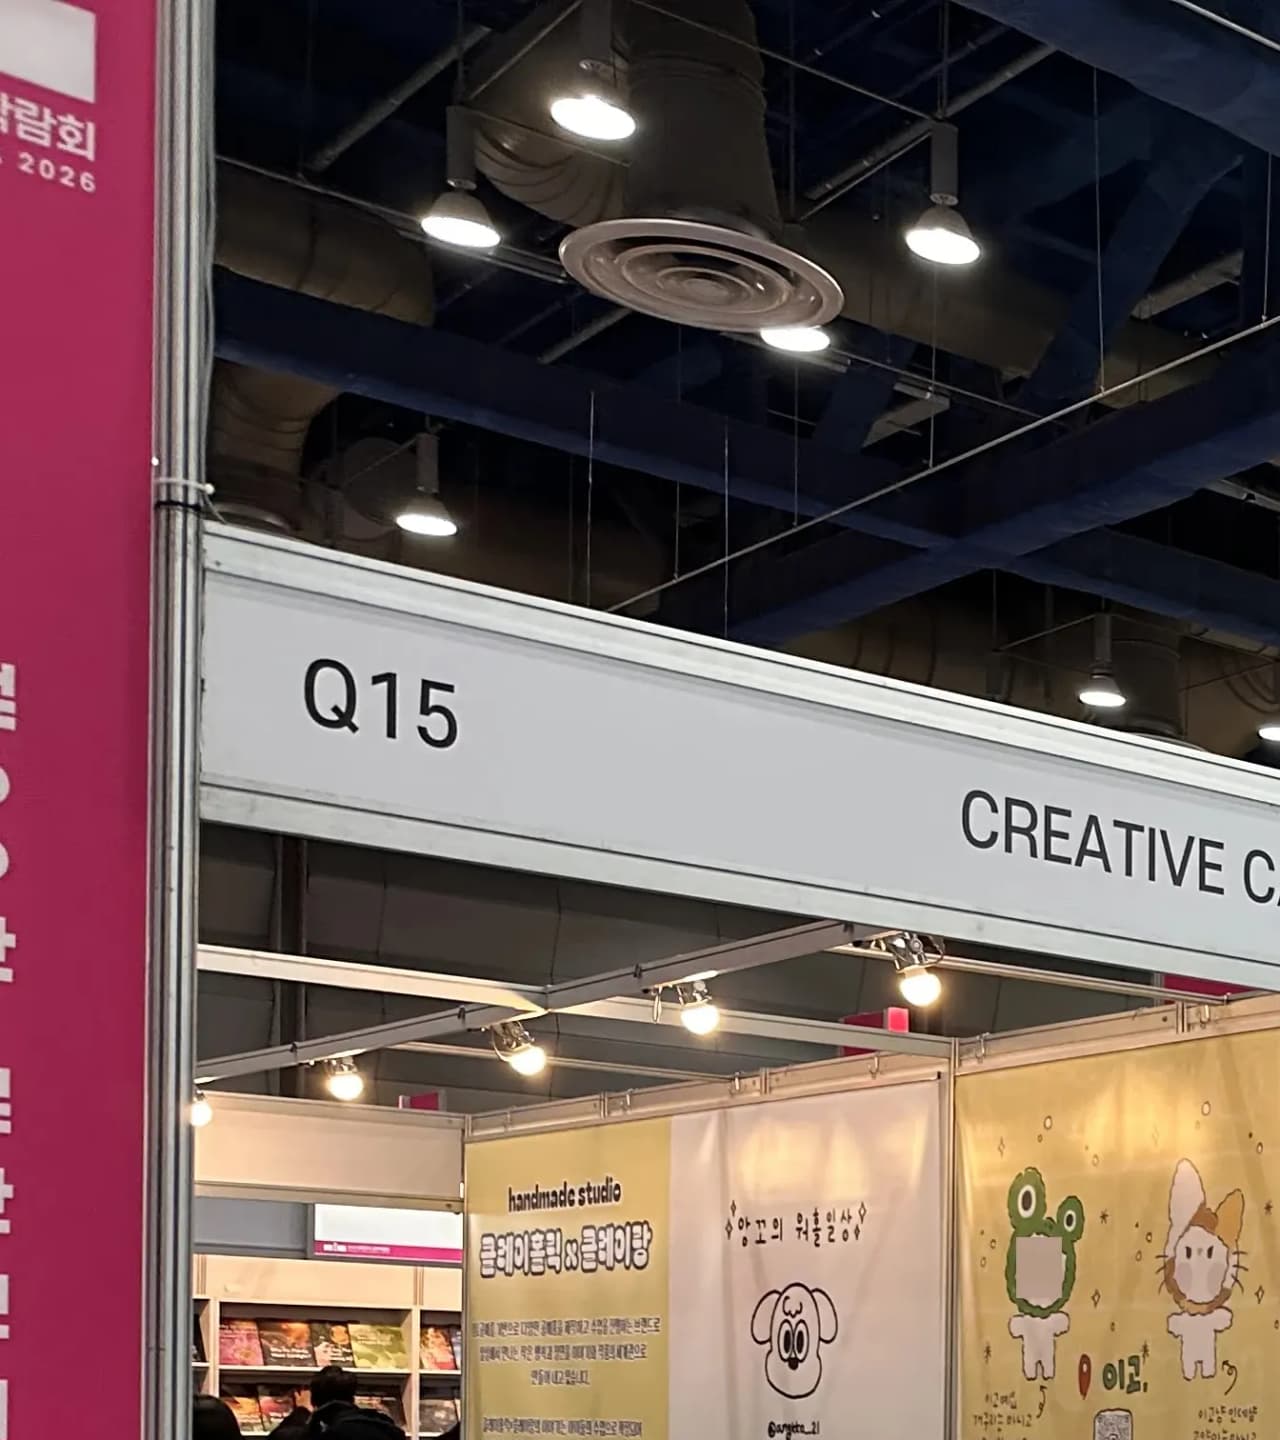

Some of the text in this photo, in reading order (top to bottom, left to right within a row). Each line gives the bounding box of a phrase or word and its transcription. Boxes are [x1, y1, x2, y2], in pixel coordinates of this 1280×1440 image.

[0, 91, 96, 161] 람회
[19, 151, 96, 194] 2026
[303, 657, 460, 750] Q15
[961, 788, 1226, 896] CREATIVE
[508, 1176, 621, 1213] handmade studio
